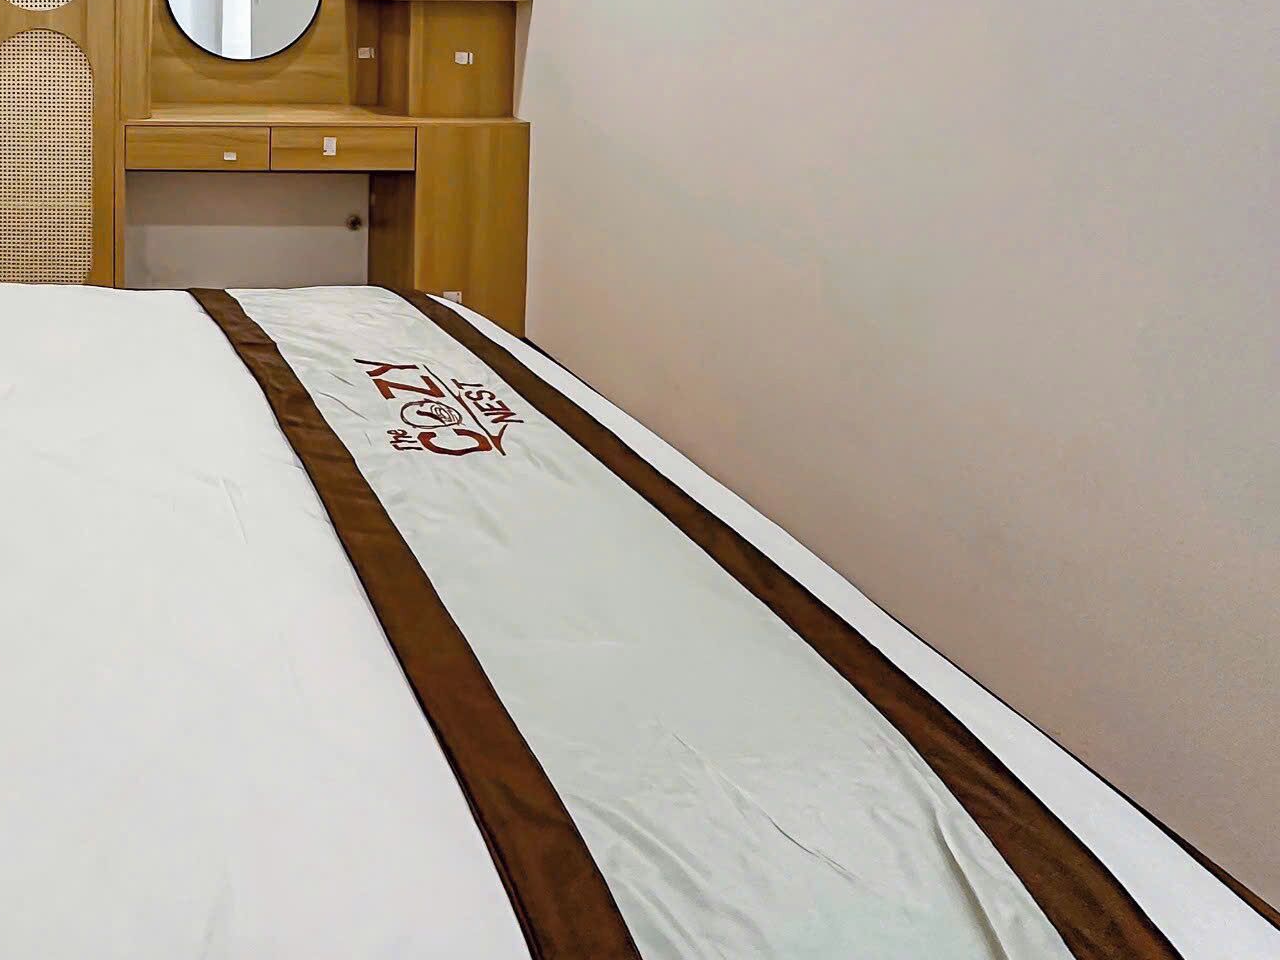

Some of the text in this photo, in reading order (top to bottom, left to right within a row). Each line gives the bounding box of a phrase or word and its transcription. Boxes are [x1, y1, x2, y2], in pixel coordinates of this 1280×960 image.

[355, 359, 493, 456] COZY
[451, 378, 524, 424] NEST
[387, 428, 423, 451] The
